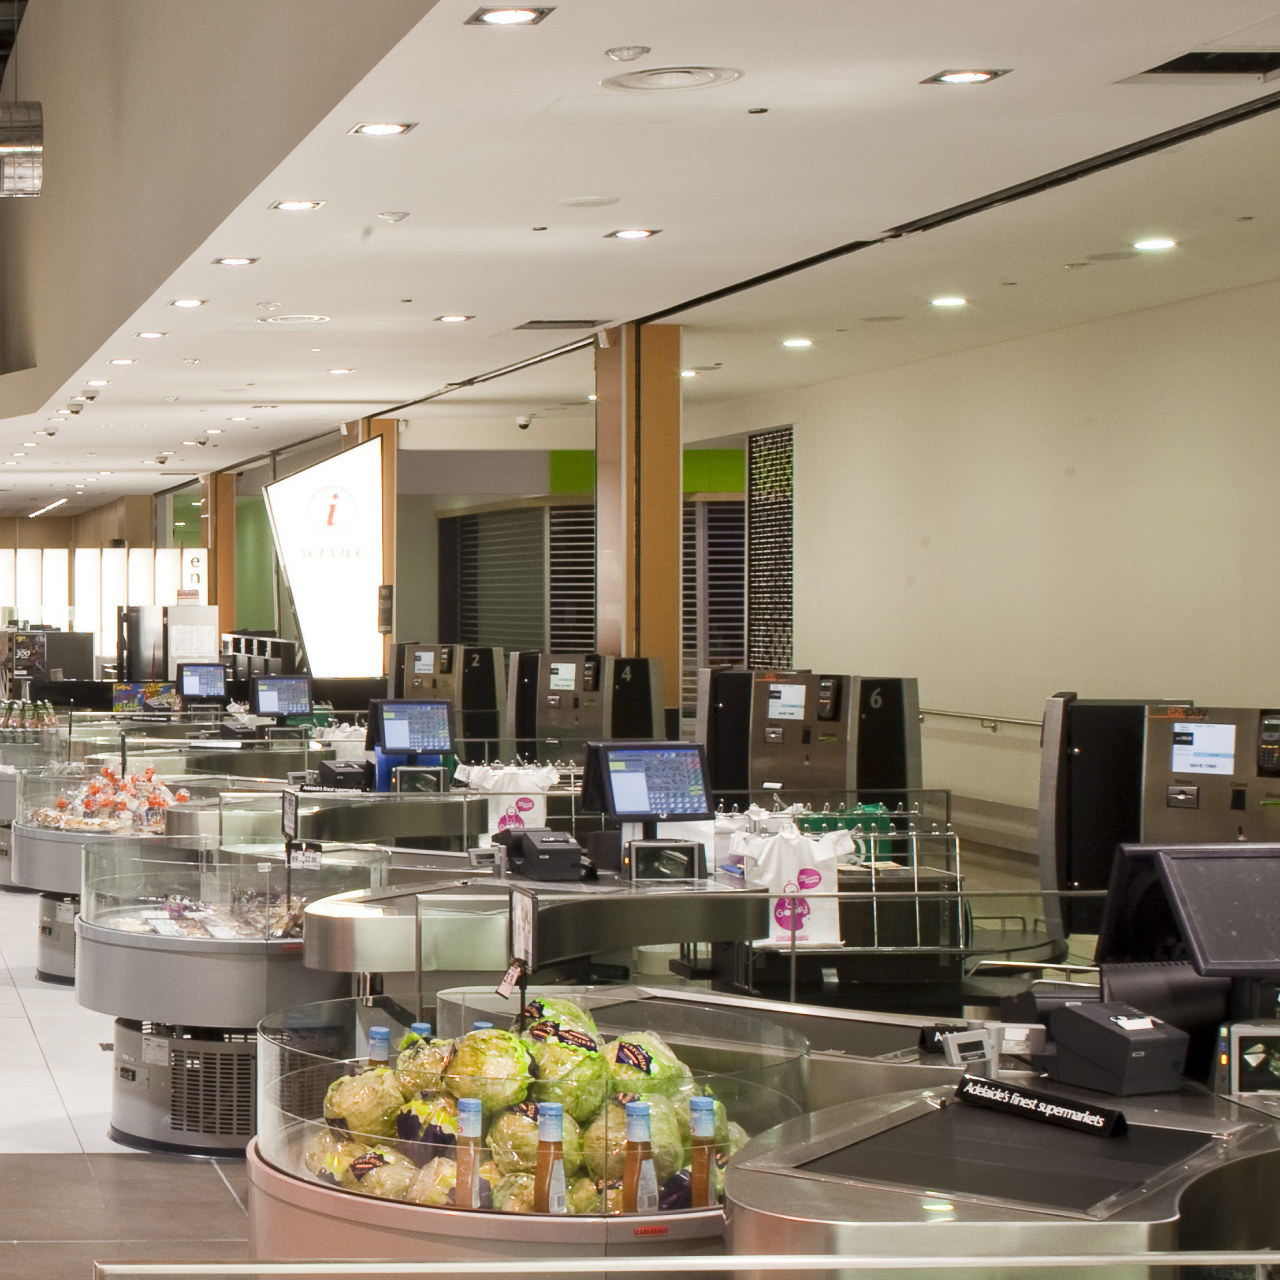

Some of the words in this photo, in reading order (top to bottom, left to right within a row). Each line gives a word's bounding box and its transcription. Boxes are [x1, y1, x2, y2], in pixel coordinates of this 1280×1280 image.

[472, 654, 480, 667] 2
[621, 666, 631, 681] 4
[870, 688, 882, 709] 6
[963, 1082, 1011, 1103] Adelaide's
[1009, 1093, 1038, 1110] finest
[1037, 1101, 1106, 1127] supermarkets
